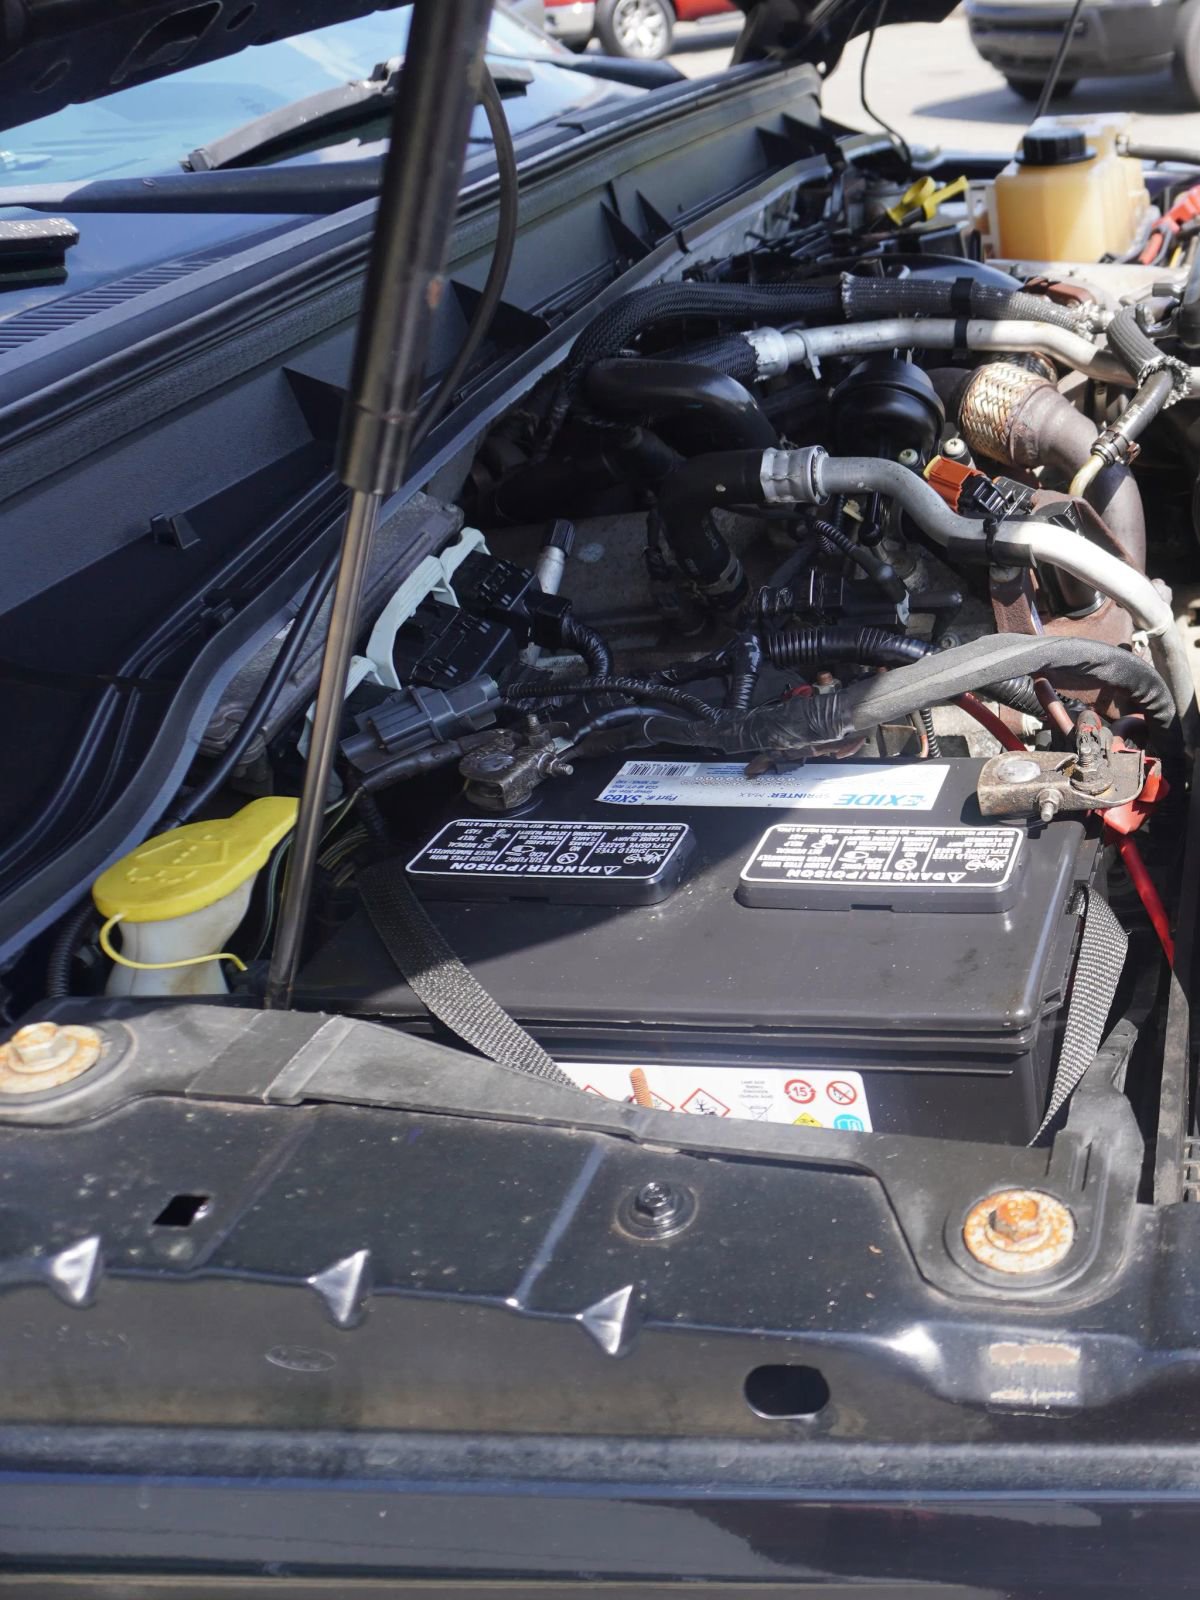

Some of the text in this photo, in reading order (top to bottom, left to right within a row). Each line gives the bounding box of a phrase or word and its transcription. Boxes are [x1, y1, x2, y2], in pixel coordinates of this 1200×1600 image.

[603, 795, 641, 803] SX65
[833, 794, 924, 806] EXIDE
[449, 862, 602, 873] DANGER/POISON
[786, 869, 946, 881] DANGER/POISON
[793, 1086, 808, 1097] 15
